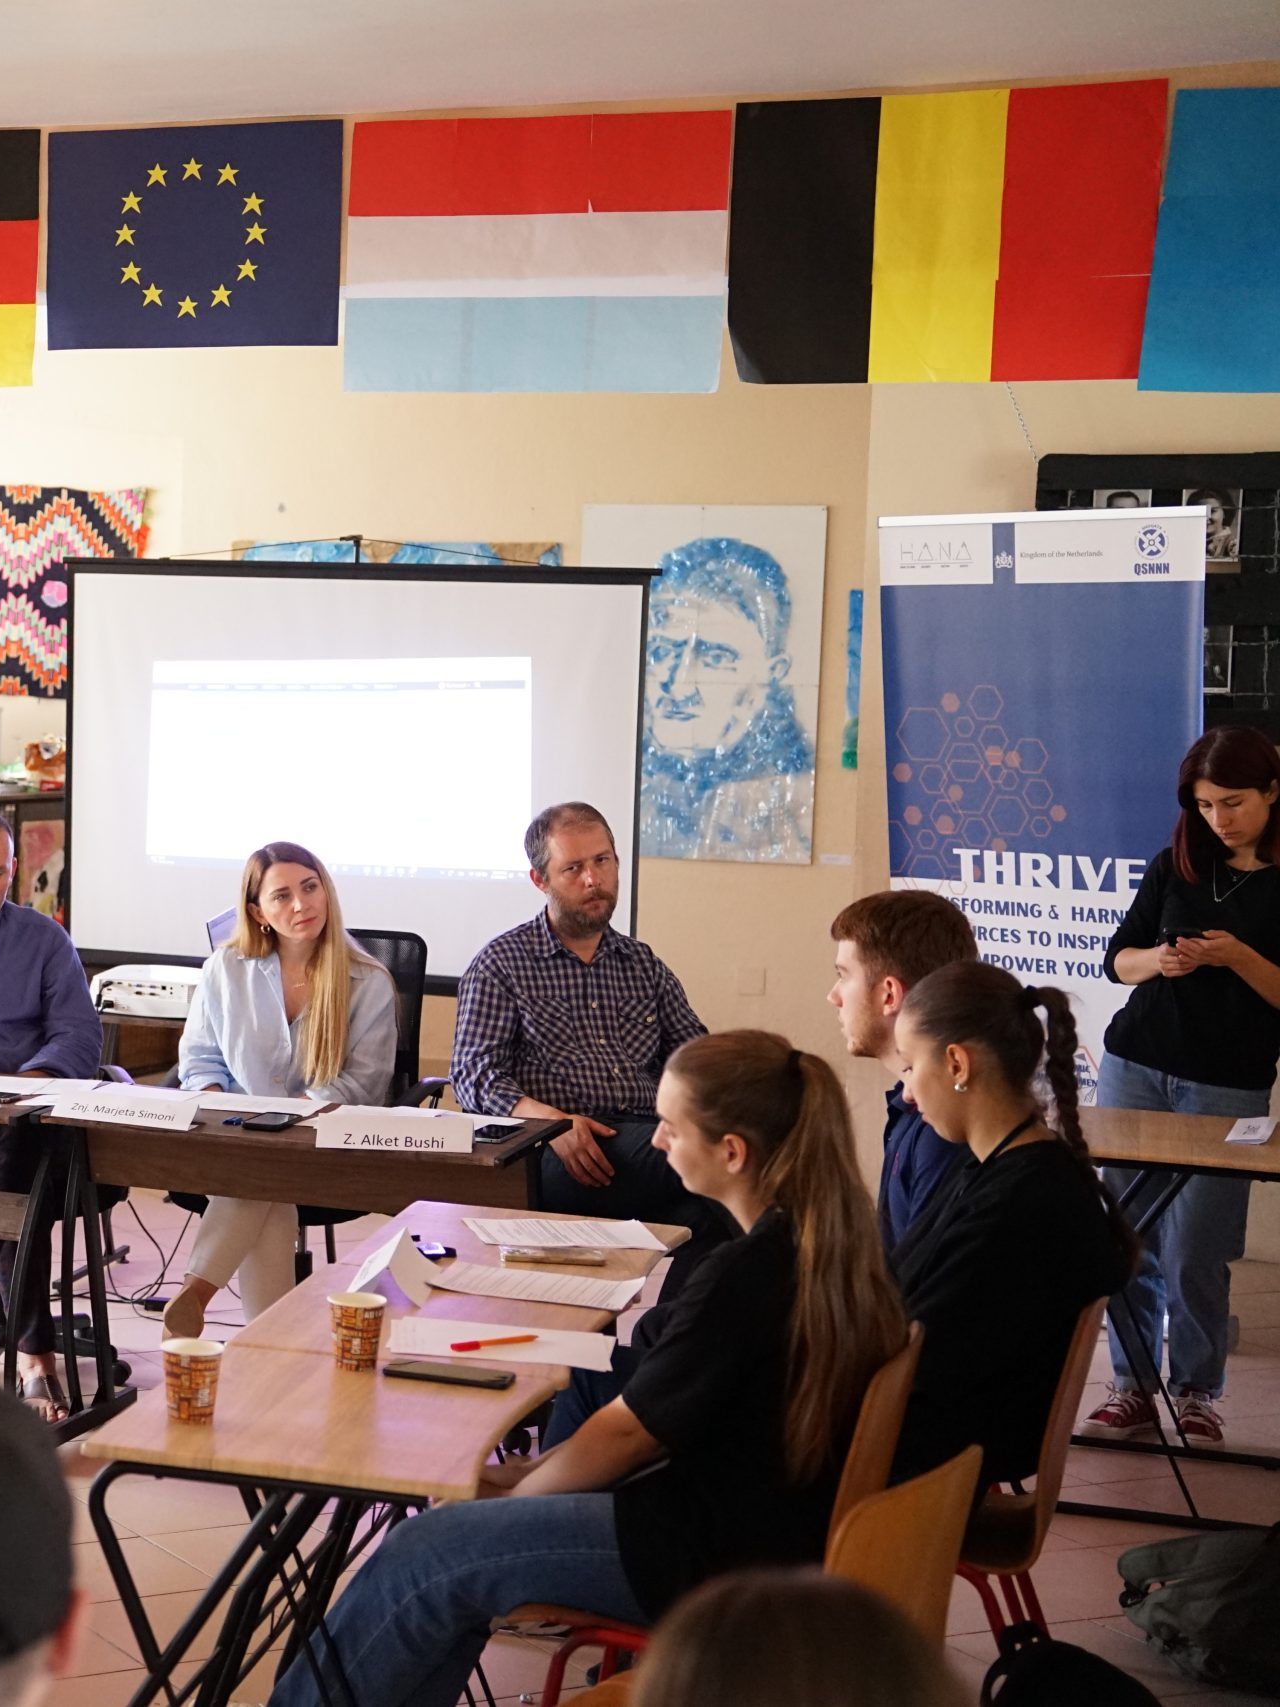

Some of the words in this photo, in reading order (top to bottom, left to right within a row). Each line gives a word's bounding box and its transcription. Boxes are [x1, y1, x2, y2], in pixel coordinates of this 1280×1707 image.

[1020, 551, 1047, 559] Kingdom
[1134, 563, 1170, 575] QSNNN
[952, 848, 1147, 893] THRIVE
[946, 896, 1042, 918] SFORMING
[1048, 905, 1059, 920] &
[1071, 906, 1128, 926] HARN
[1027, 930, 1051, 947] TO
[1058, 933, 1113, 951] INSPI
[71, 1102, 90, 1112] Znj.
[93, 1105, 135, 1117] Marjeta
[138, 1110, 176, 1122] Simoni
[343, 1133, 356, 1145] Z.
[361, 1134, 400, 1147] Alket
[404, 1136, 445, 1149] Bushi
